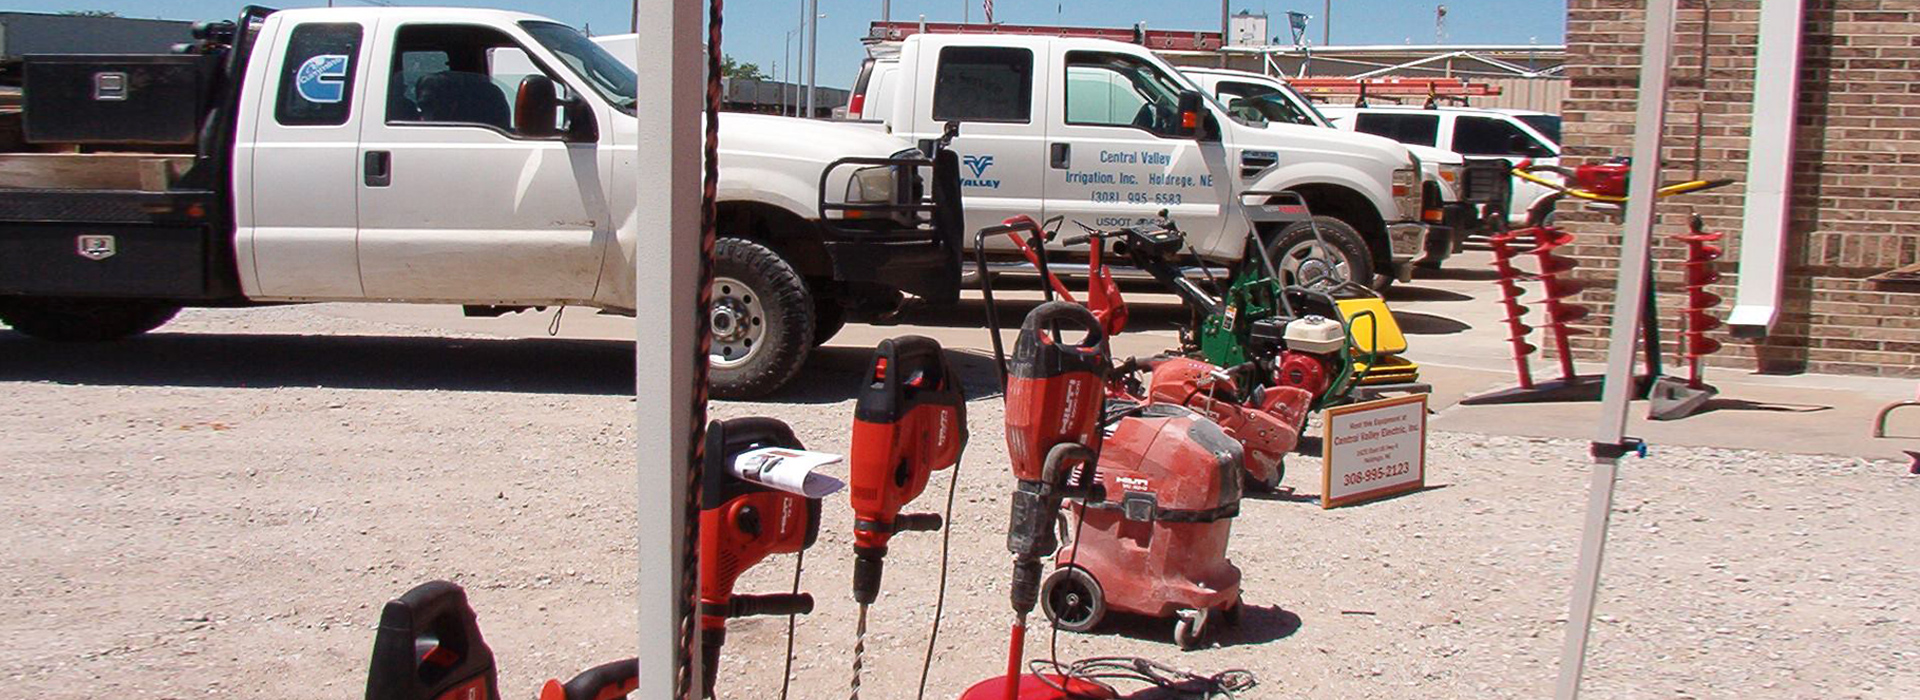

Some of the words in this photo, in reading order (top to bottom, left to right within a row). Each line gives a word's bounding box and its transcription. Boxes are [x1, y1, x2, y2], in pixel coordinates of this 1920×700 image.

[1100, 150, 1137, 163] Central
[1141, 152, 1171, 166] Valley
[1119, 172, 1138, 185] Inc.
[1200, 174, 1213, 187] NE
[1091, 191, 1120, 204] (308)
[1096, 217, 1132, 227] USDOT
[1060, 379, 1076, 435] HILTI
[1334, 435, 1359, 445] Central
[1361, 431, 1380, 441] Valley
[1344, 462, 1409, 486] 308-995-2123
